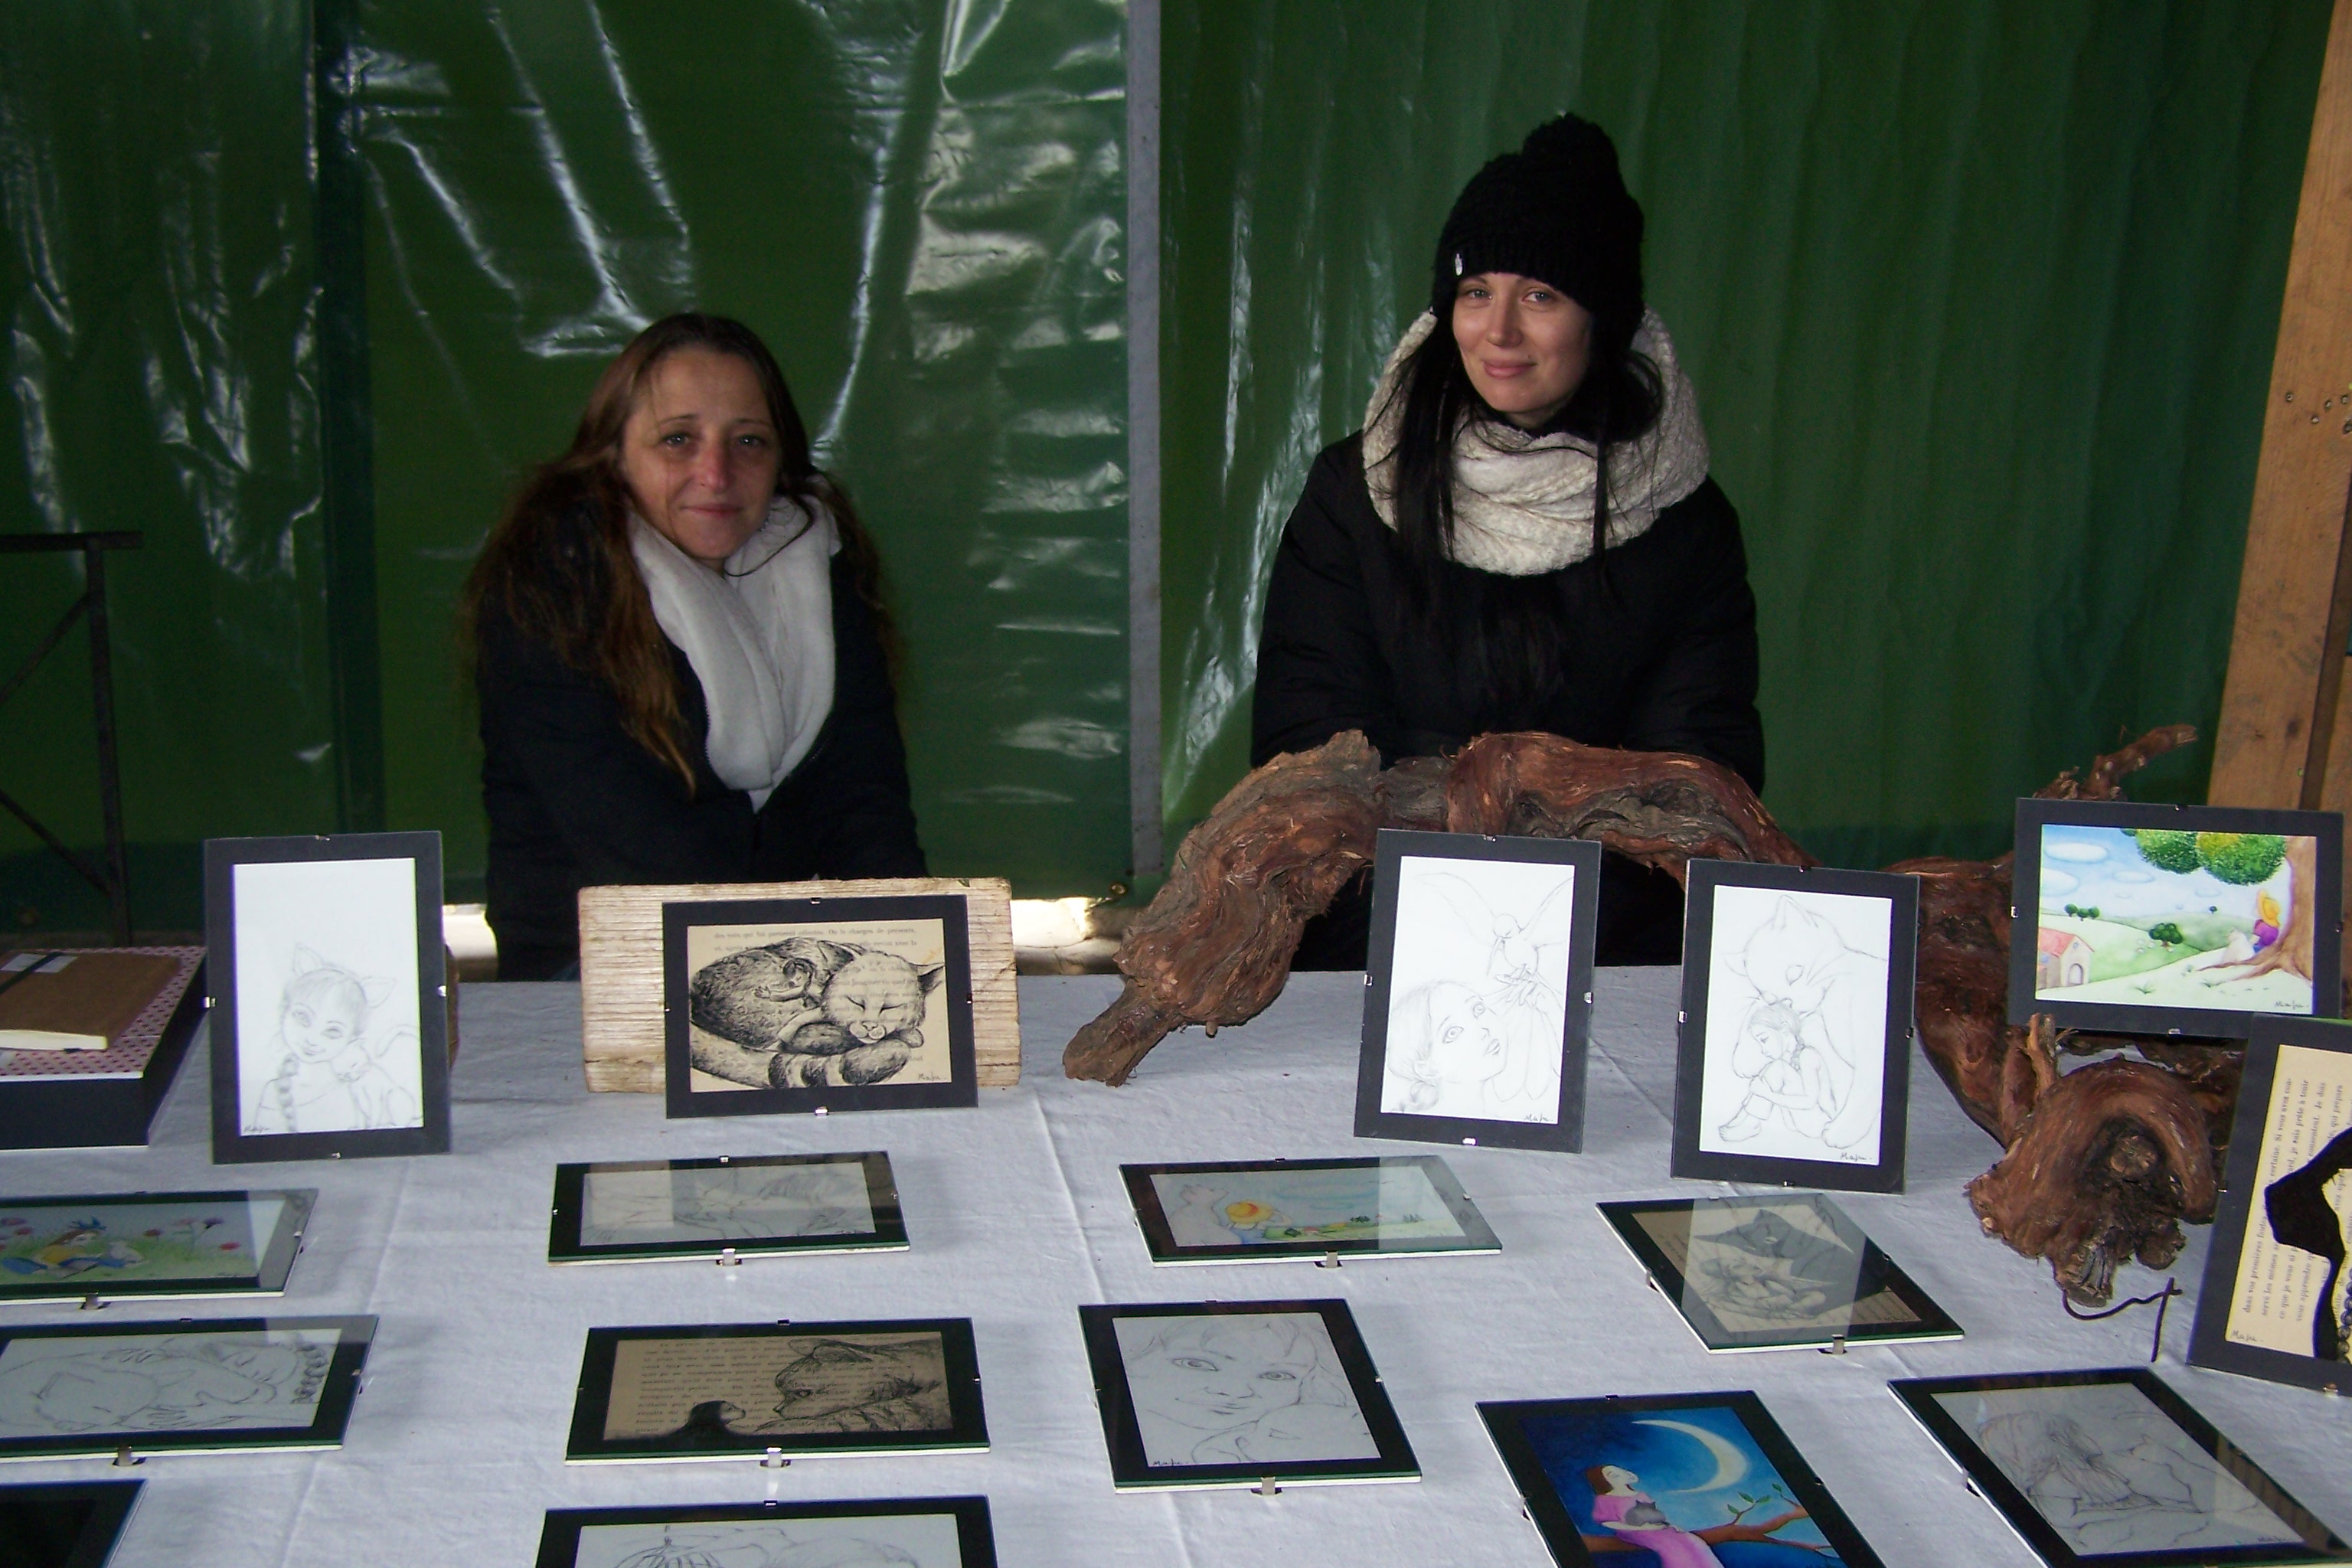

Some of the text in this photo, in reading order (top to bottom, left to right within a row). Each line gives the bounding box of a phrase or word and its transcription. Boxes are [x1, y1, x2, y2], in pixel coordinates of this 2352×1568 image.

[2299, 1080, 2308, 1097] tenir
[2316, 1083, 2326, 1097] dois
[2281, 1096, 2289, 1112] avez
[2331, 1116, 2339, 1128] qui
[2243, 1295, 2252, 1313] dans
[2251, 1241, 2262, 1279] premières
[2263, 1282, 2272, 1294] les
[2268, 1254, 2278, 1280] mêmes
[2283, 1285, 2292, 1293] je
[2296, 1305, 2305, 1321] vous
[2301, 1263, 2311, 1301] apprendre
[2281, 1294, 2289, 1308] que
